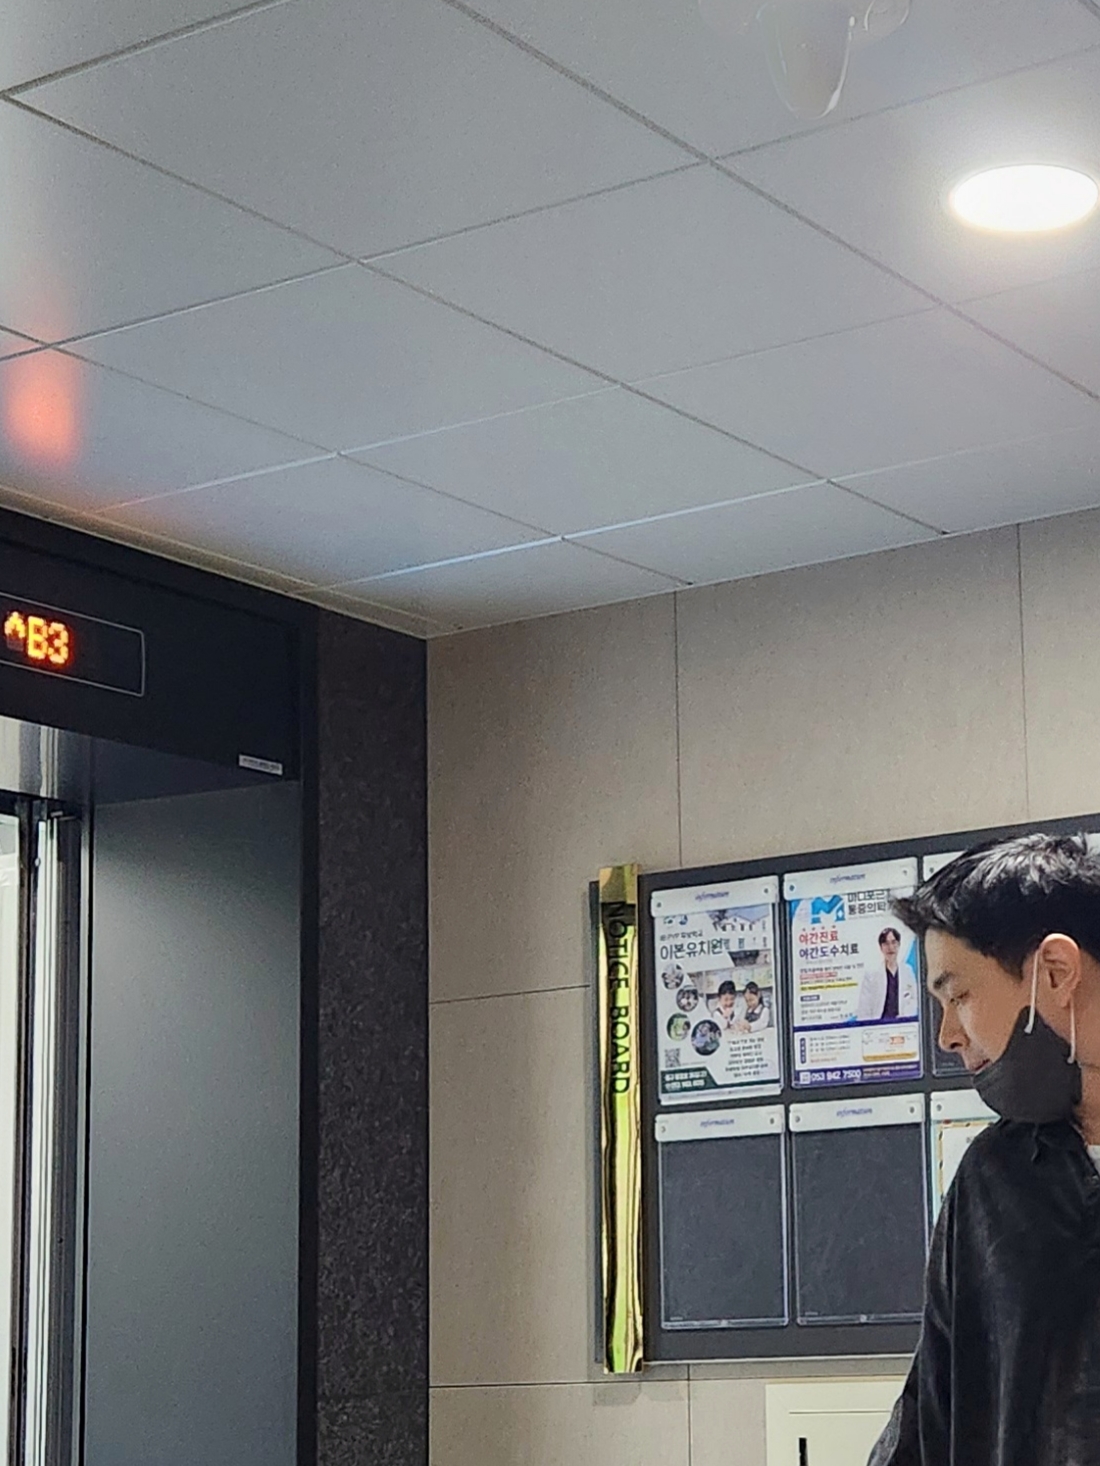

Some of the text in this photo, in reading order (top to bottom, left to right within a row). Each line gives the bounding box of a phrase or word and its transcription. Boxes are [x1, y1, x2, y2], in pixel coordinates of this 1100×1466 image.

[26, 615, 69, 666] B3
[660, 937, 723, 960] 이본유치원
[798, 930, 839, 946] 야간진료
[798, 942, 859, 960] 야간도수치료
[607, 901, 630, 1094] NOTICE BOARD
